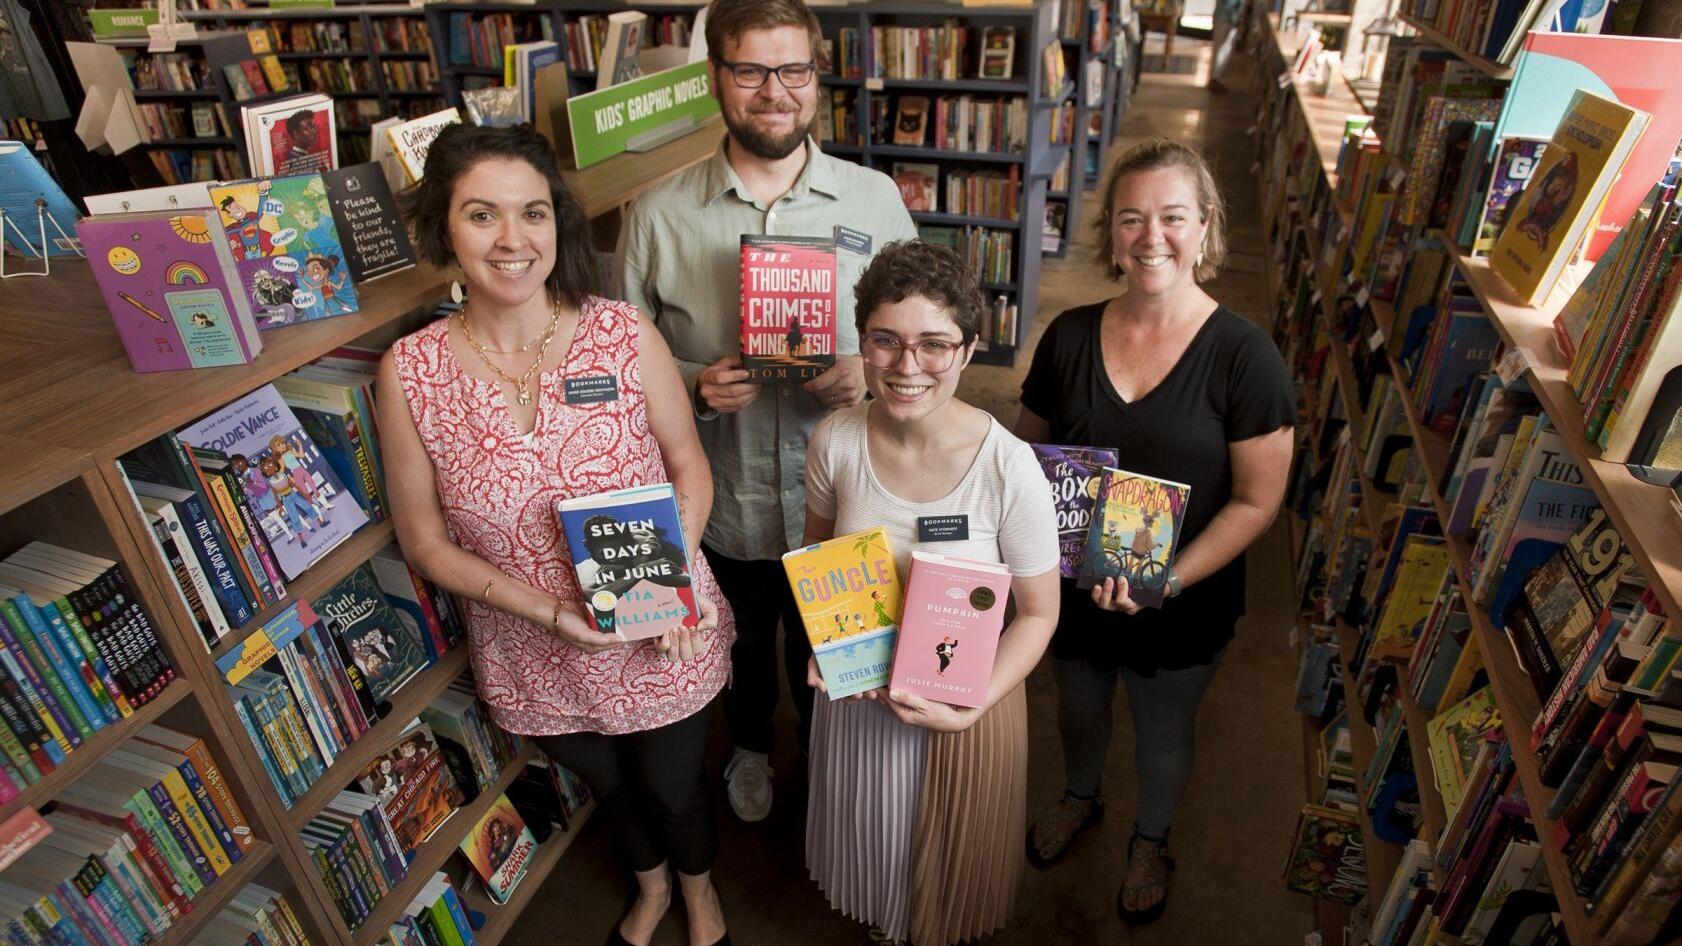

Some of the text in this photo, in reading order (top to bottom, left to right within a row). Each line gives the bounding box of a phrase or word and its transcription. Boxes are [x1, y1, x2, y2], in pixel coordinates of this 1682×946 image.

[112, 16, 146, 26] ROMANCE
[595, 75, 709, 134] KIDS' GRAPHIC NOVELS
[402, 122, 448, 147] CARDBOA
[266, 204, 282, 213] DC
[343, 196, 376, 210] Please
[344, 204, 382, 221] be kind
[352, 217, 382, 230] to our
[353, 227, 392, 244] friends,
[357, 238, 396, 254] they are
[363, 246, 398, 266] fragile!
[749, 252, 791, 262] THE
[749, 268, 831, 293] THOUSAND
[749, 298, 830, 328] CRIMES OF
[749, 333, 831, 355] MING TSU
[571, 379, 610, 388] BOOKMARKS
[751, 369, 787, 378] TOM
[241, 406, 280, 435] VANCE
[1055, 462, 1073, 477] The
[1538, 450, 1584, 484] THIS
[1051, 476, 1090, 504] BOX
[1101, 474, 1184, 515] SNAPDRAGON
[1070, 500, 1079, 509] the
[1538, 503, 1565, 519] THE
[591, 519, 654, 537] SEVEN
[1056, 507, 1092, 528] OOD
[195, 518, 236, 589] THIS WAS OUR PACT
[603, 544, 652, 559] DAYS
[1570, 507, 1634, 603] 191
[594, 564, 672, 584] IN JUNE
[797, 560, 892, 604] GUNCLE
[326, 593, 356, 618] Little
[623, 591, 653, 602] TIA
[597, 606, 690, 628] WILLIAMS
[927, 604, 980, 619] PUMPKIN
[129, 619, 150, 653] BAD GUYS
[136, 612, 157, 646] BAD GUYS
[106, 636, 129, 670] BAD GUYS
[115, 631, 136, 665] BAD GUYS
[122, 626, 143, 660] BAD GUYS
[242, 641, 271, 664] GRAPHIC
[97, 641, 120, 675] BAD GUYS
[251, 648, 276, 669] NOVELS
[838, 665, 871, 683] STEVEN
[872, 661, 892, 674] ROW
[906, 676, 973, 694] JULIE MURPHY
[299, 697, 312, 717] ILLEGAL
[205, 766, 220, 785] 104
[388, 756, 440, 821] GREAT CHICAGO FIRE
[168, 812, 180, 824] 52
[501, 841, 533, 889] SUMMER
[502, 843, 524, 877] SHARK
